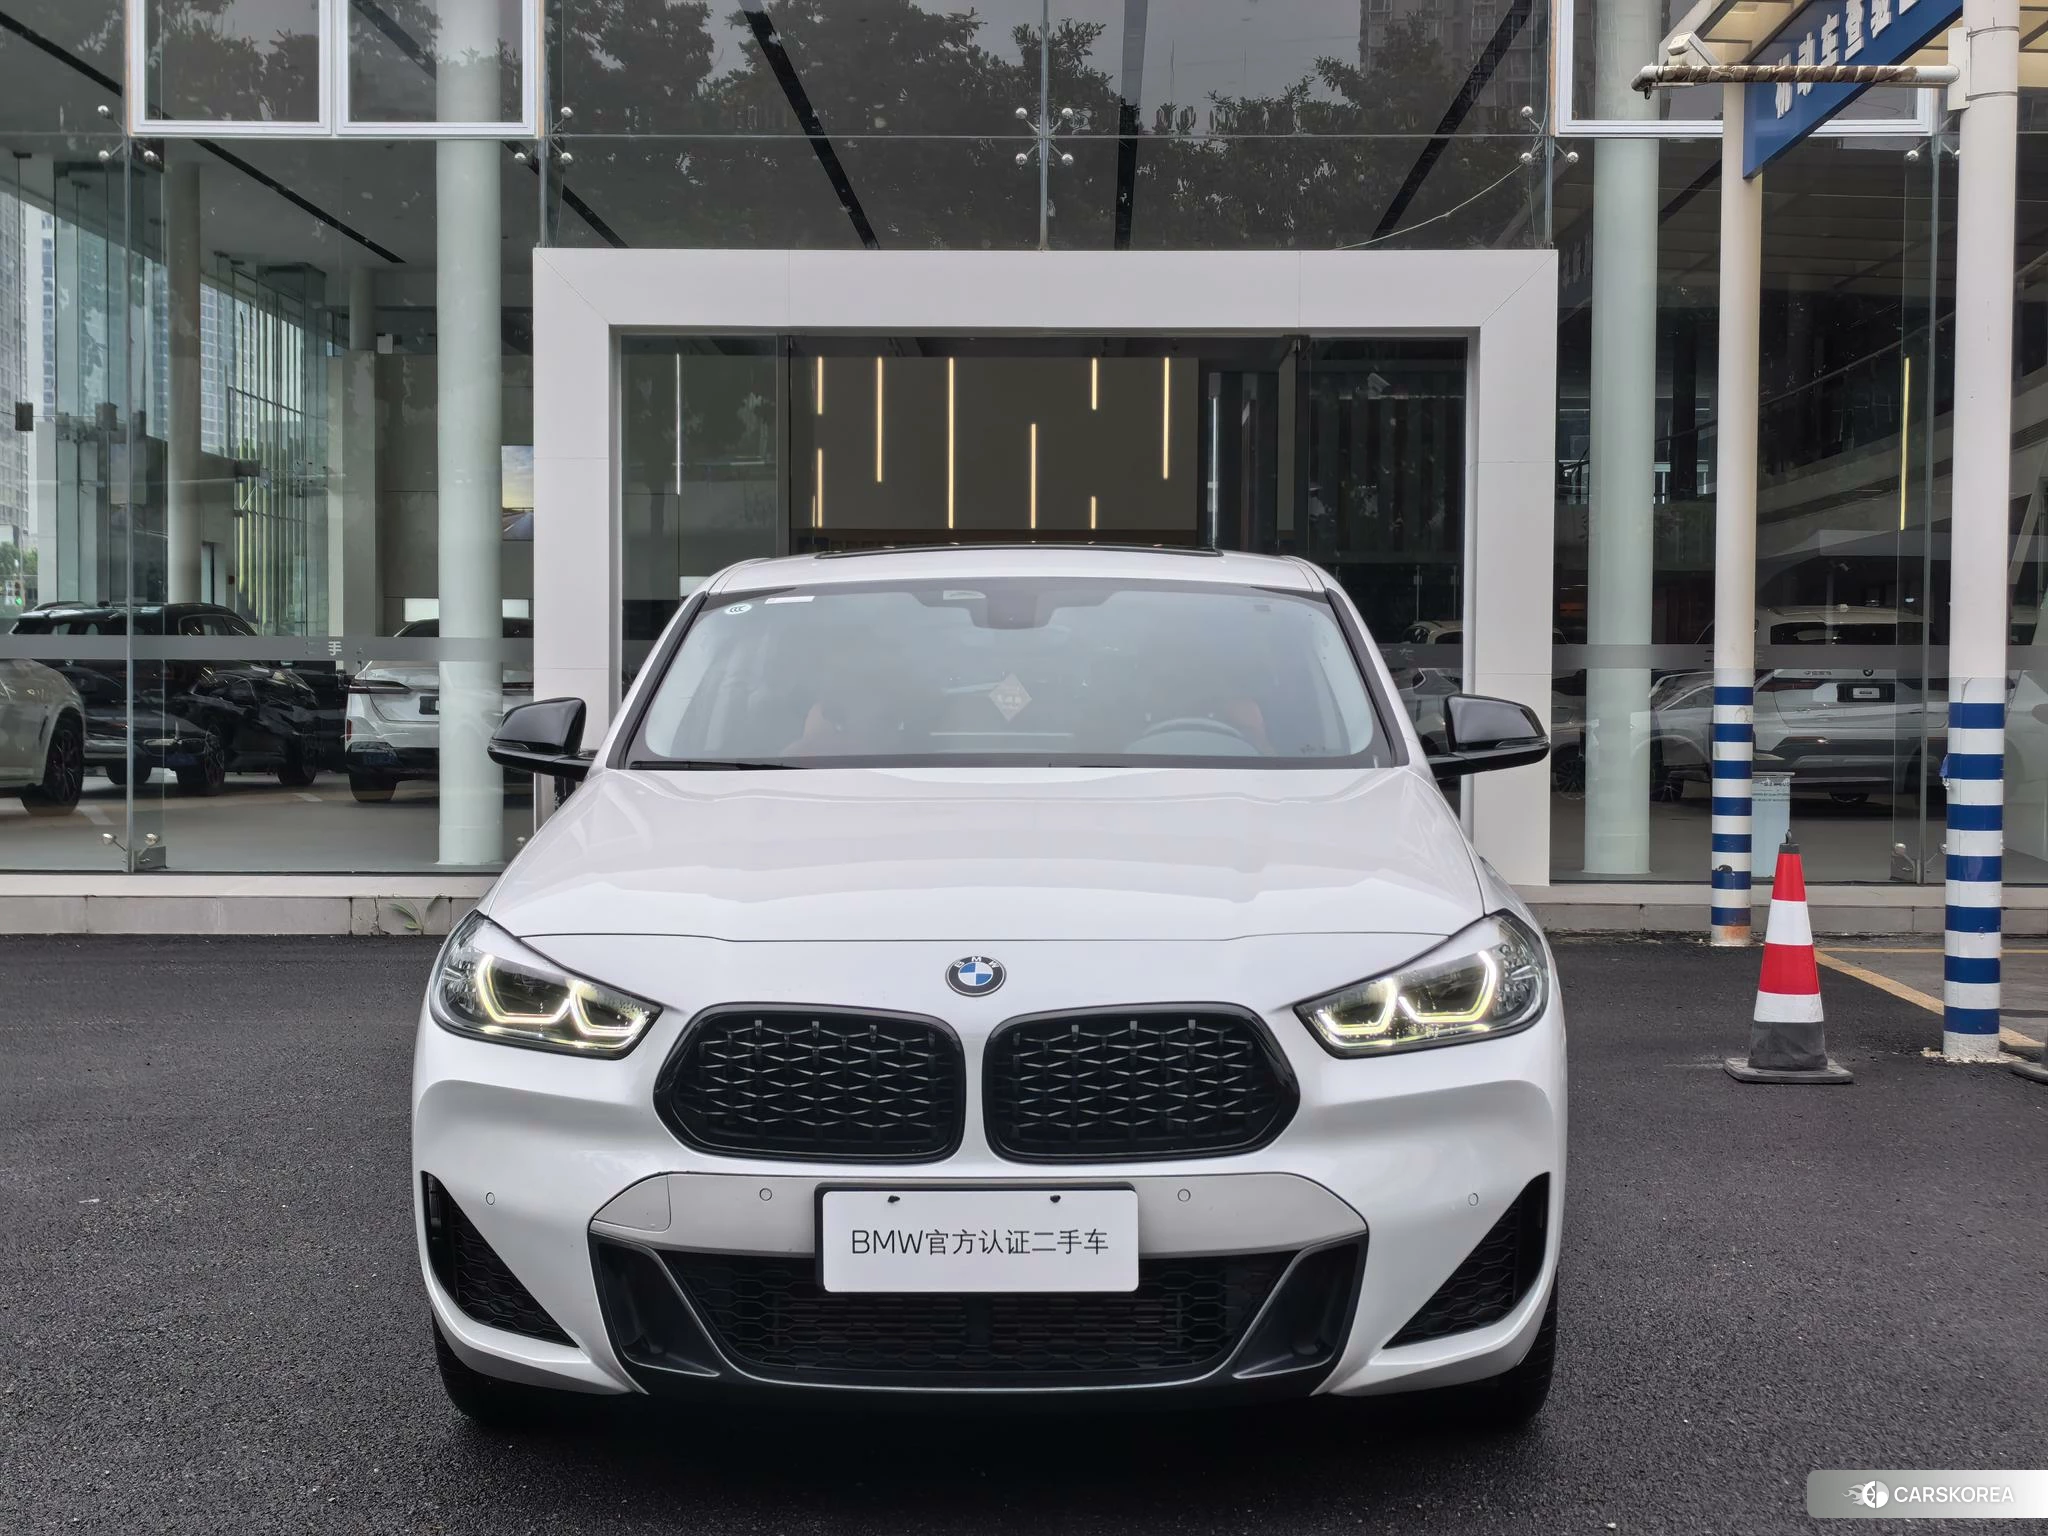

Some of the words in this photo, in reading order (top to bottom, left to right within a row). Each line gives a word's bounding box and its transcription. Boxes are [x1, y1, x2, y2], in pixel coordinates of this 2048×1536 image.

[954, 956, 1000, 968] BMW
[851, 1228, 1109, 1255] BMW官方认证二手车
